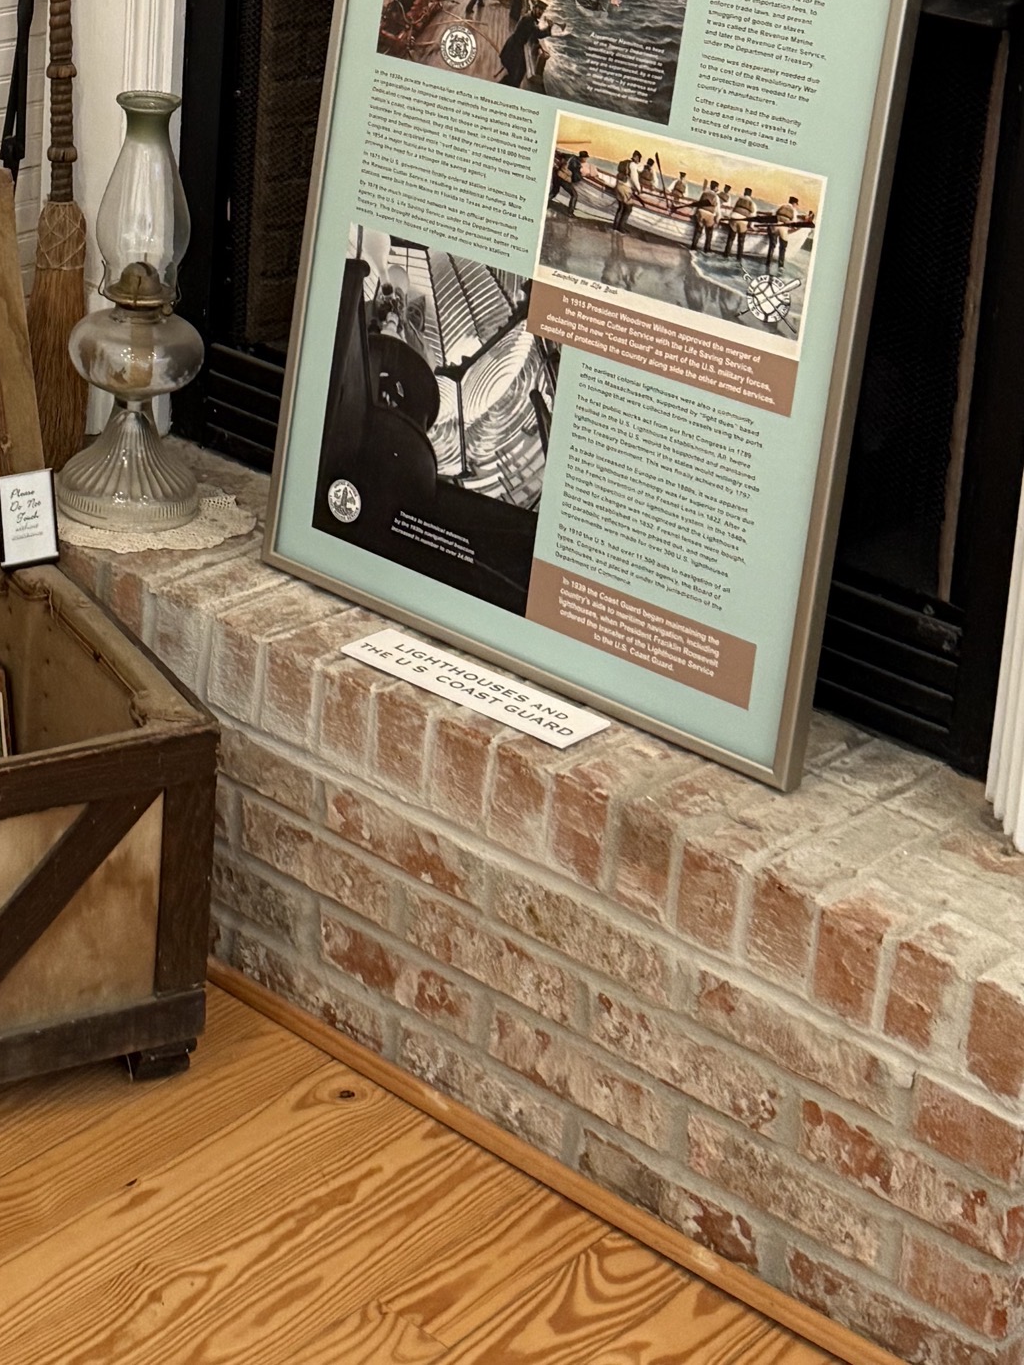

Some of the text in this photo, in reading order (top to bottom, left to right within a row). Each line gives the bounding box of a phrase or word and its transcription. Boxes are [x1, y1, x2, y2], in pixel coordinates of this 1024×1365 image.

[561, 294, 761, 363] In 1915 President Woodrow Wilson approved the merger of
[564, 307, 576, 317] the
[576, 310, 606, 326] Revenue
[605, 319, 628, 333] Cutter
[628, 326, 654, 342] Service
[654, 337, 670, 347] with
[670, 340, 683, 351] the
[683, 344, 698, 355] Life
[698, 349, 724, 365] Saving
[9, 498, 42, 512] Do Not
[10, 488, 35, 500] Please
[16, 511, 39, 524] Touch
[360, 642, 575, 737] THE U S COAST GUARD
[394, 643, 569, 720] LIGHTHOUSES AND
